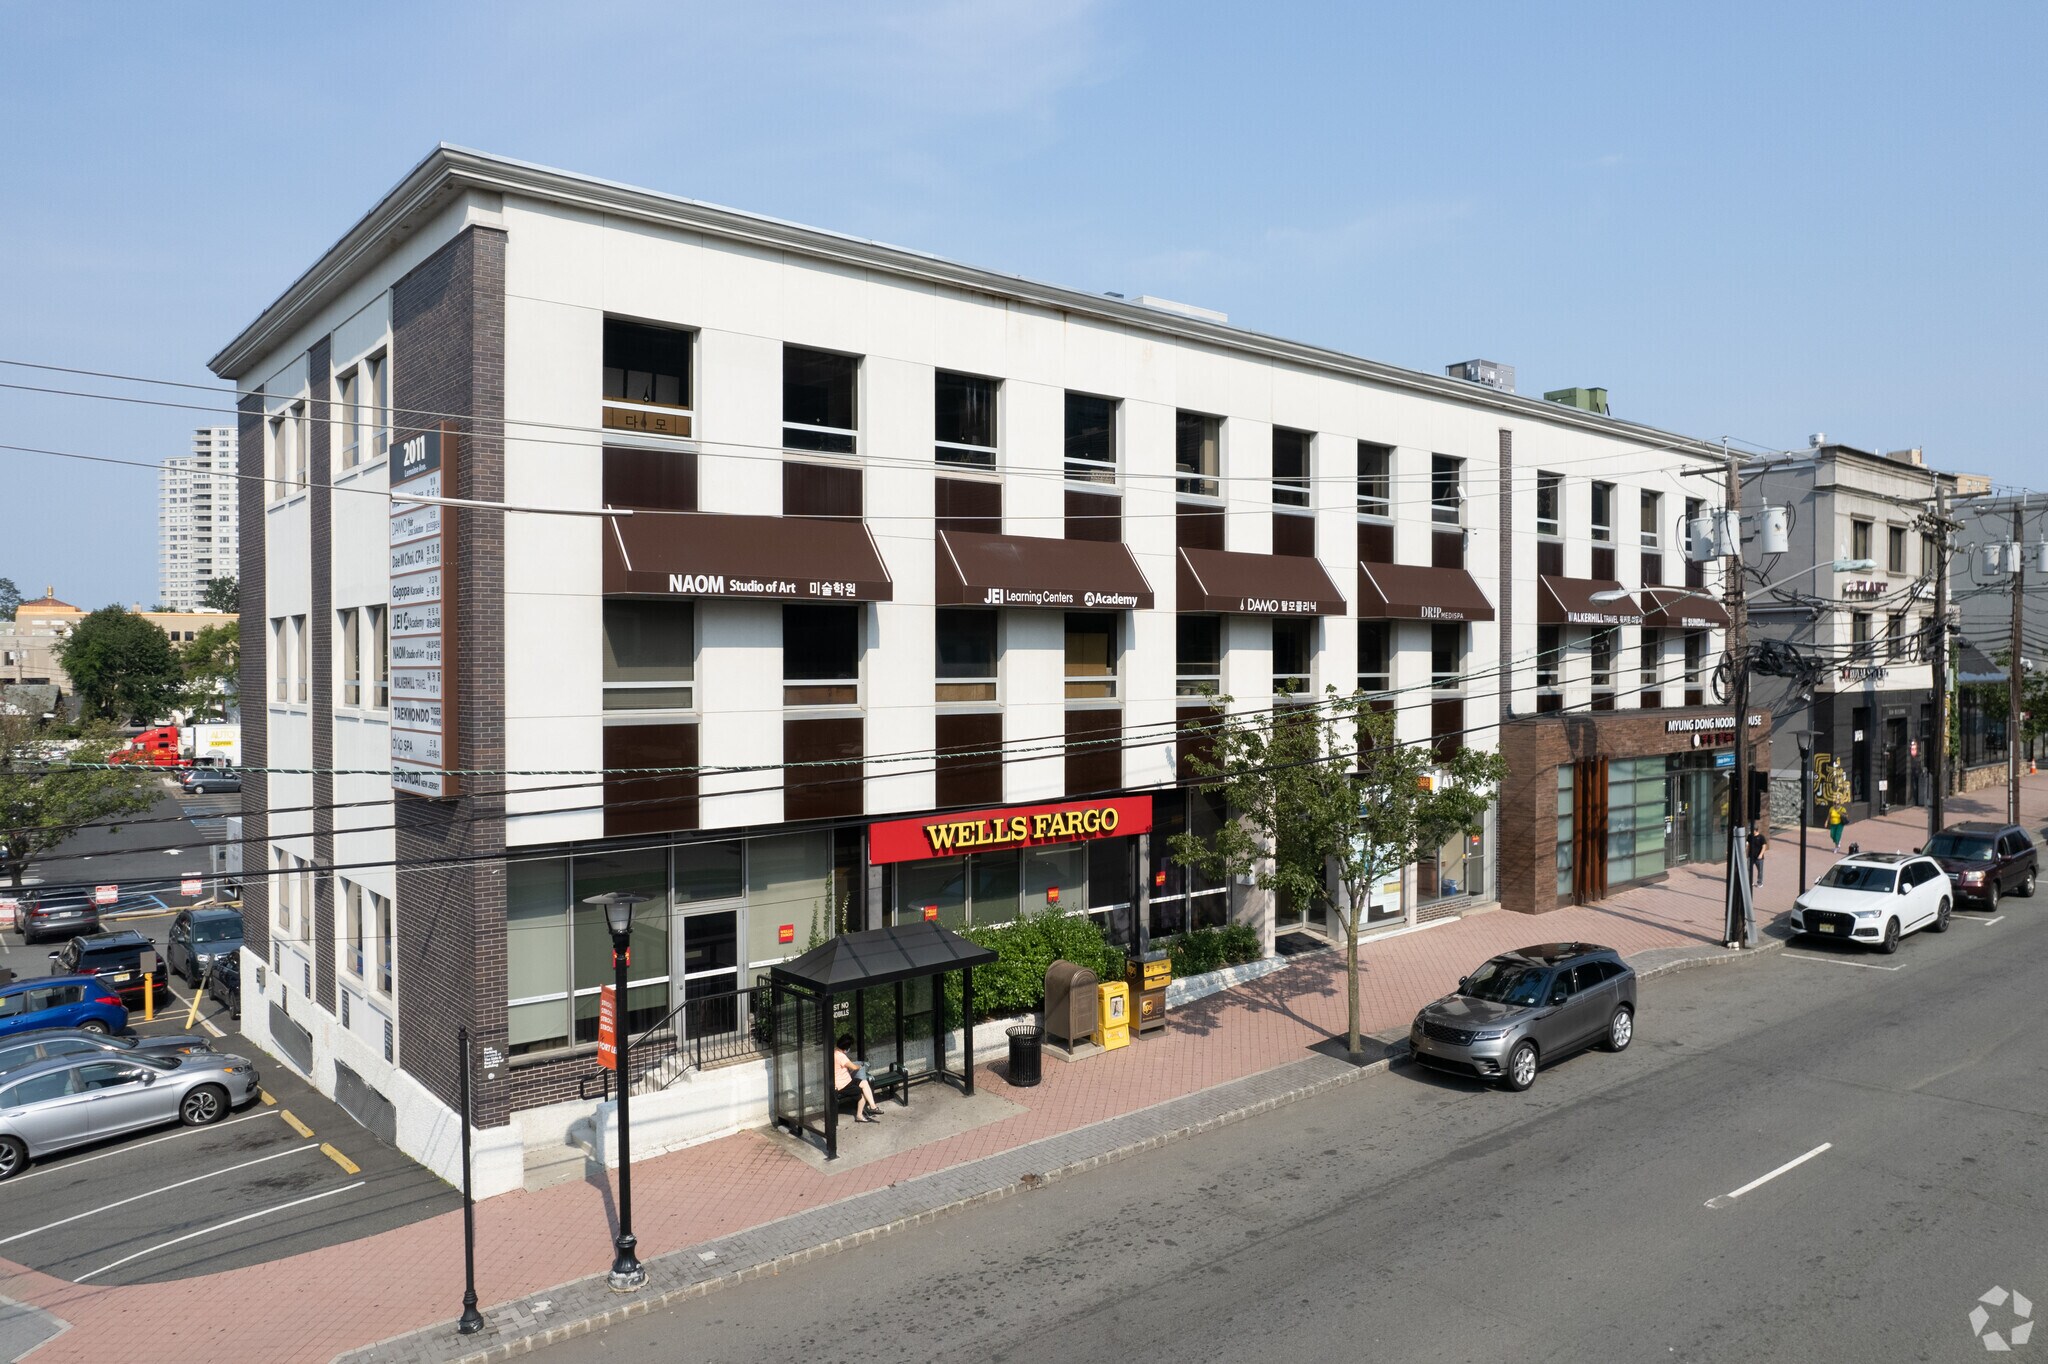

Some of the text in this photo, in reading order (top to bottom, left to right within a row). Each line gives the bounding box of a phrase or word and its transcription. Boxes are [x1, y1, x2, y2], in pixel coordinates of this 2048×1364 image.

[404, 435, 426, 467] 2011
[669, 574, 796, 594] NAOM Studio of Art
[809, 584, 856, 597] 미술학원
[984, 588, 1073, 605] JEI Learning Centers
[1094, 592, 1138, 608] Academy
[1247, 598, 1278, 612] DAMO
[393, 613, 403, 630] JEI
[1568, 611, 1604, 623] WALKERHILL
[393, 646, 406, 660] NAOM
[394, 707, 430, 723] TAEKWONDO
[1668, 715, 1762, 732] MYUNG DONG NOOD USE
[404, 740, 414, 752] SPA
[926, 806, 1119, 851] WELLS FARGO
[841, 1001, 850, 1010] NO
